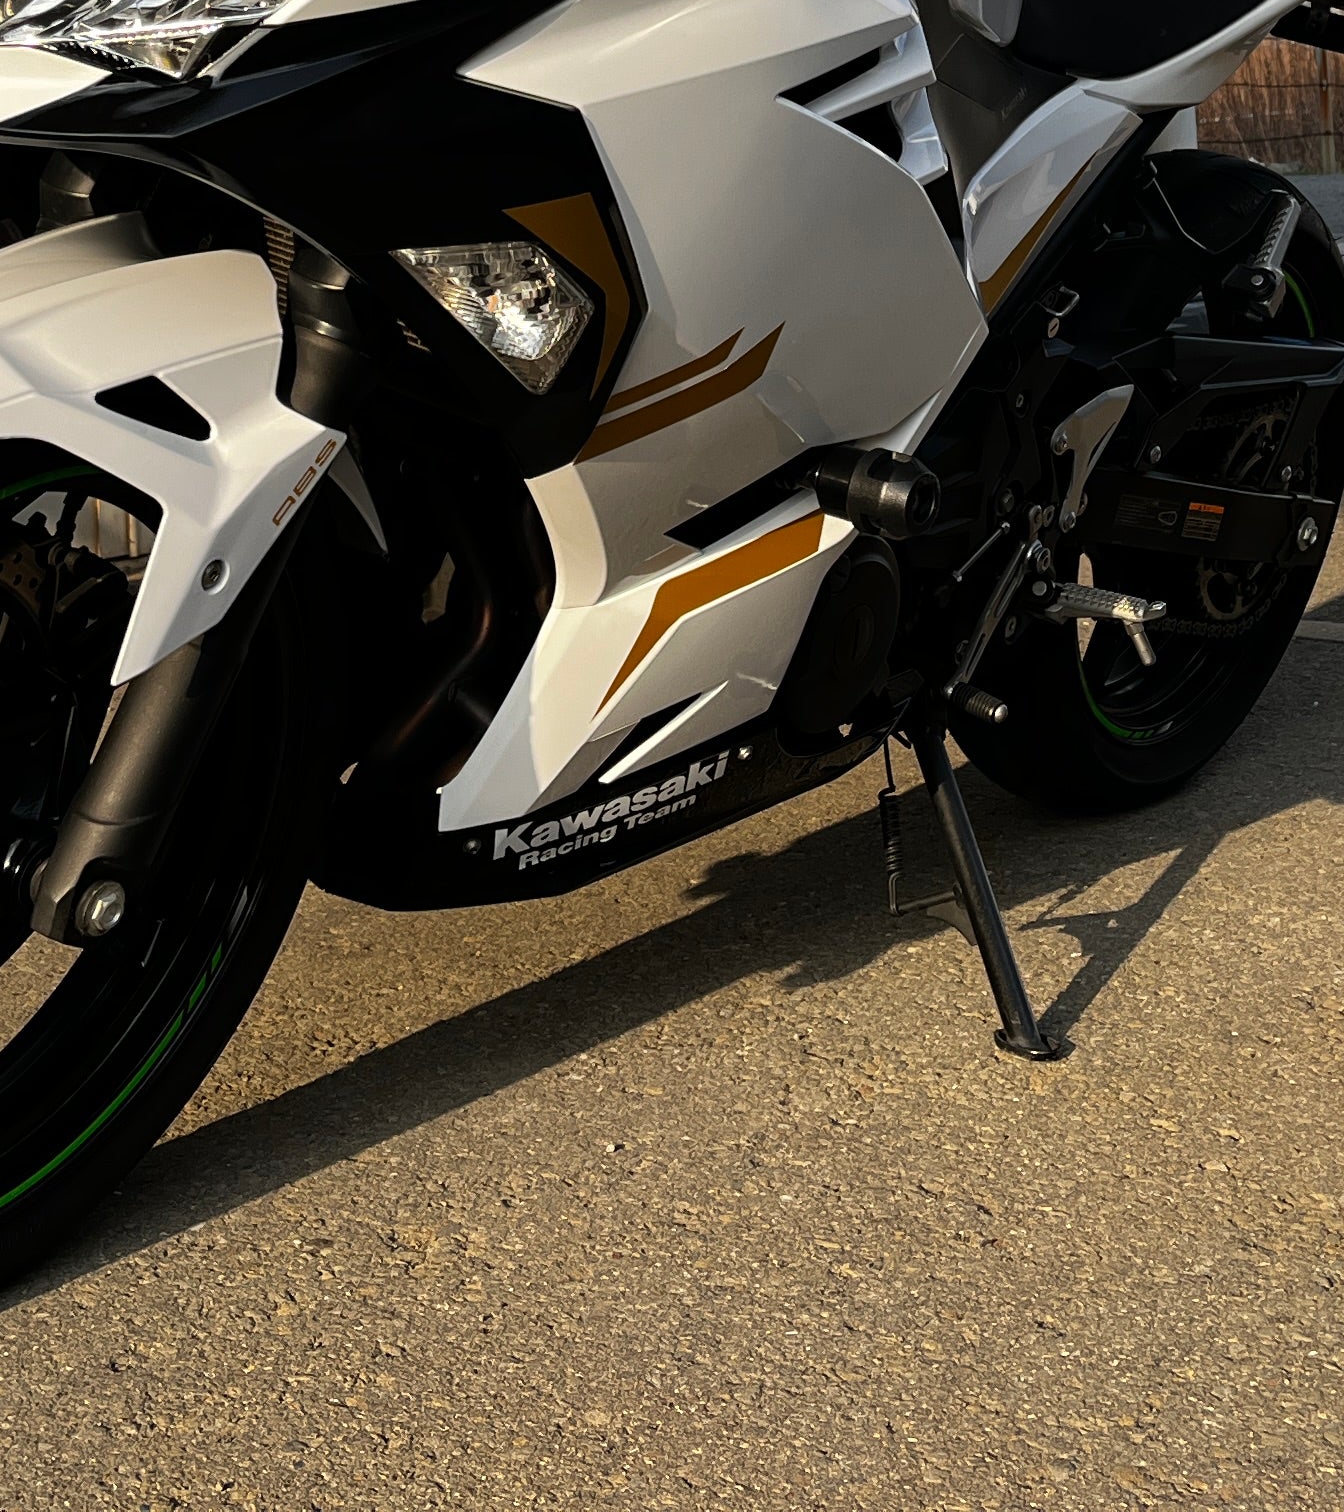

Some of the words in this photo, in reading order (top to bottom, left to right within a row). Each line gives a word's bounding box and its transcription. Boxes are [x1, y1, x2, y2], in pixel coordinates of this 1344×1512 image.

[492, 749, 732, 861] Kawasaki
[518, 824, 617, 871] Racing
[623, 793, 697, 832] Team
